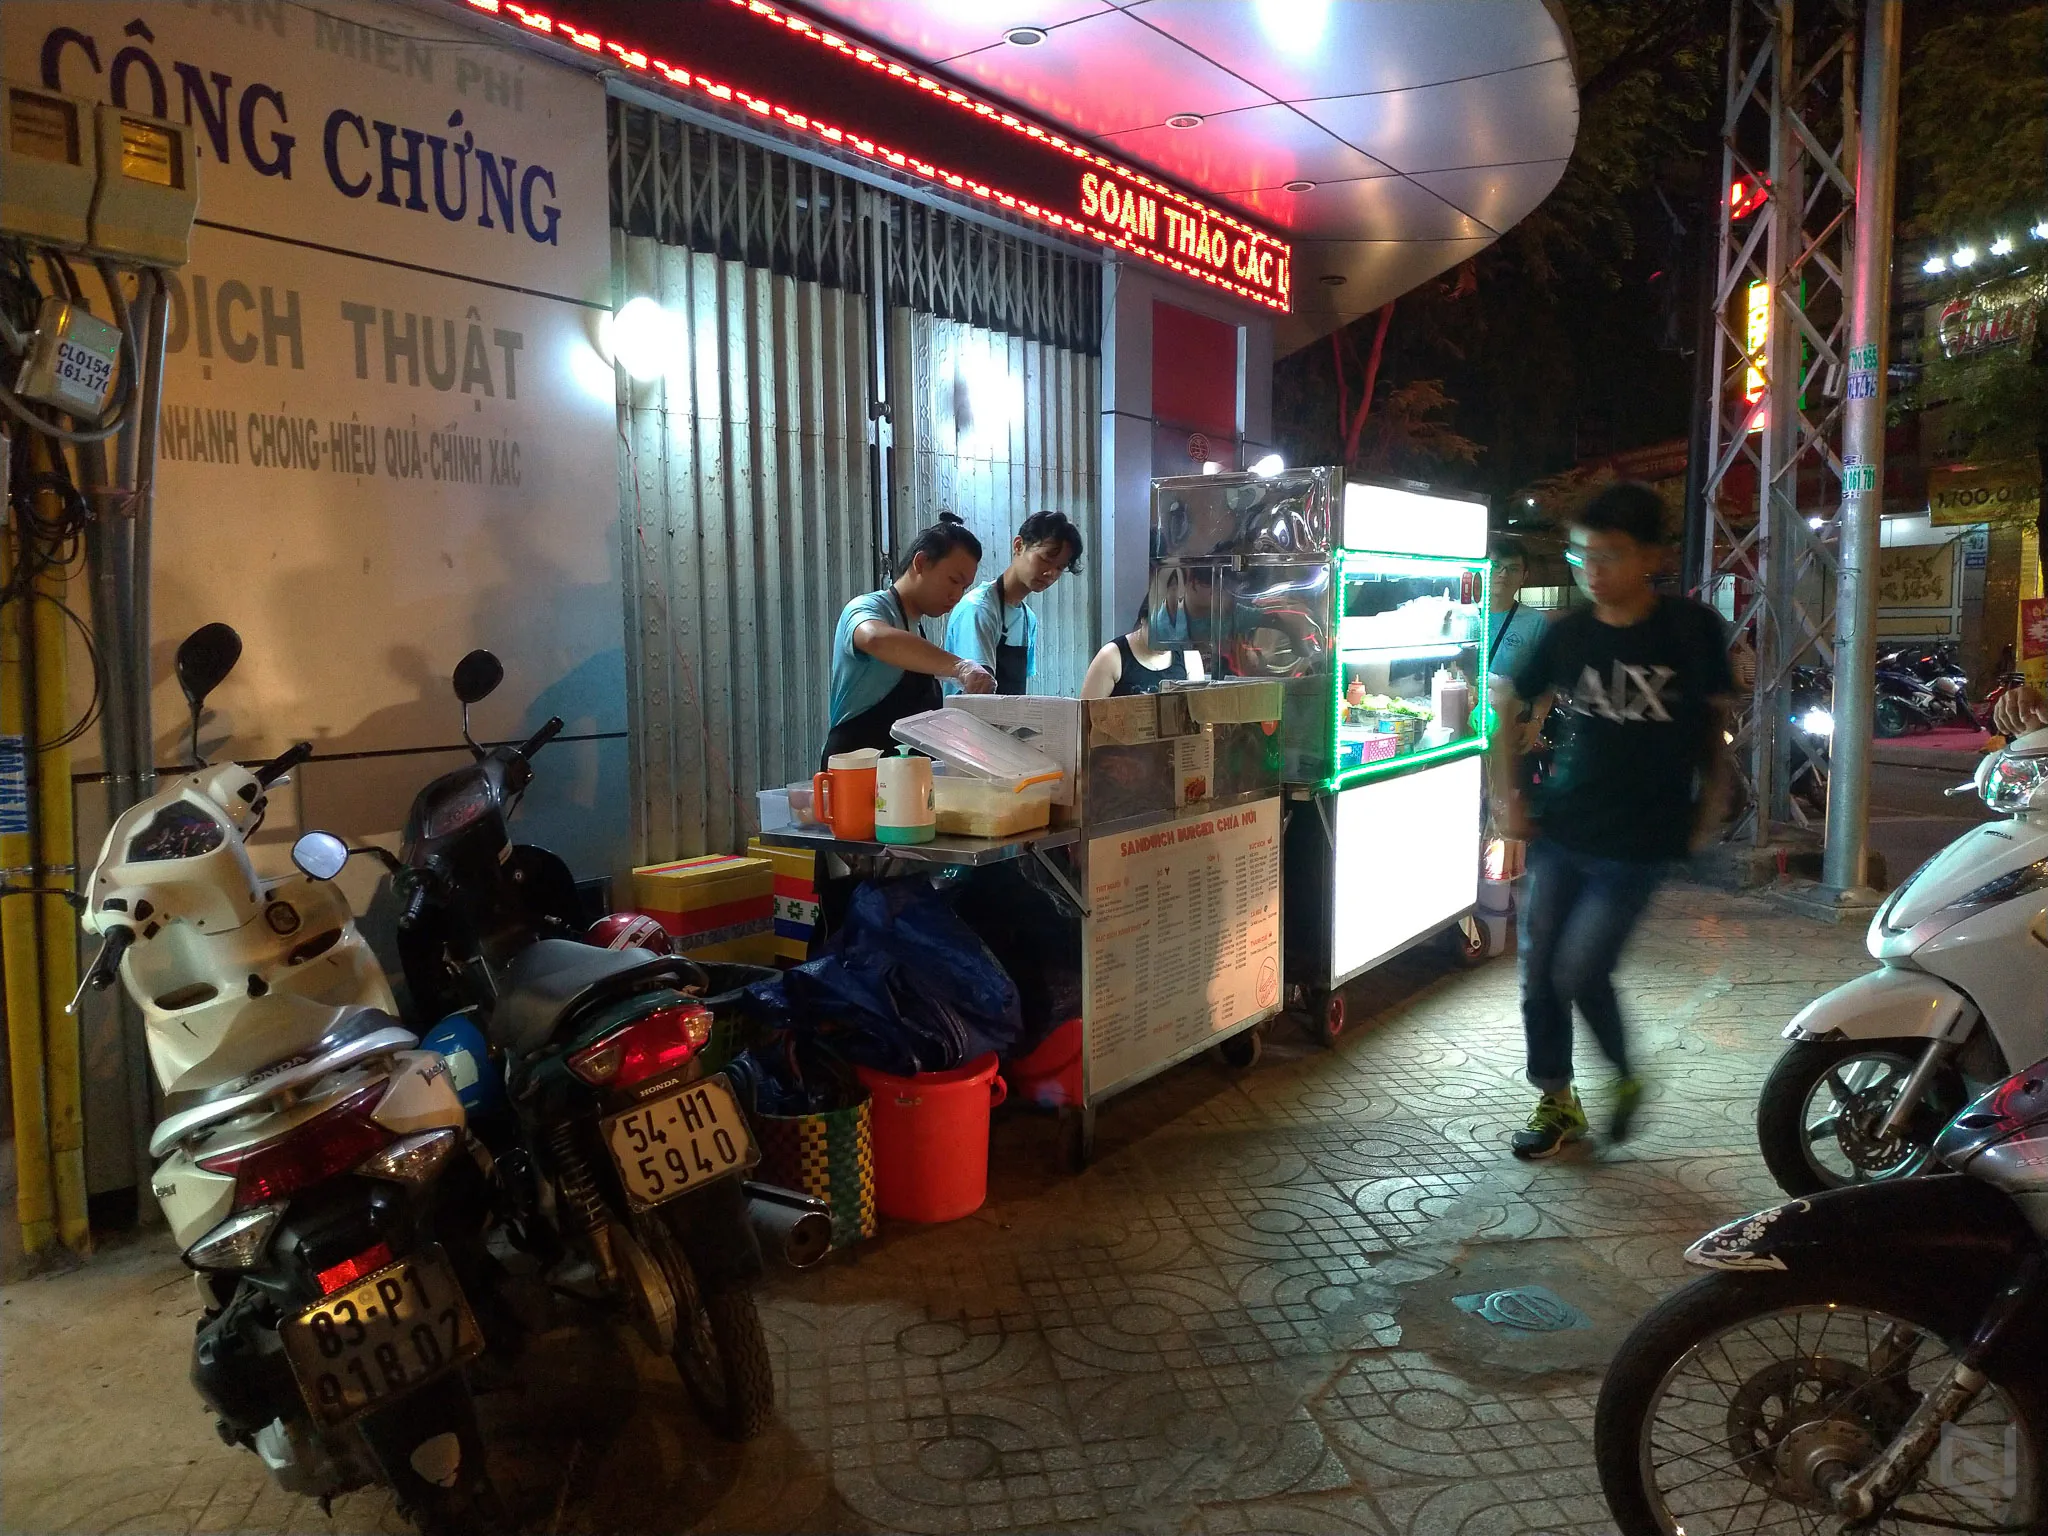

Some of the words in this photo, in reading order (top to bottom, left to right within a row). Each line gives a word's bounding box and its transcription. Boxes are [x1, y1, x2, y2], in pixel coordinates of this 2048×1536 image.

[40, 18, 297, 181] CÔNG
[322, 108, 562, 247] CHỨNG
[1080, 172, 1157, 242] SOẠN
[1163, 209, 1228, 269] THẢO
[1232, 233, 1273, 288] CÁC
[164, 273, 305, 381] DỊCH
[340, 300, 524, 412] THUẬT
[161, 404, 240, 465] NHANH
[1120, 829, 1175, 858] SANDWICH
[1177, 820, 1215, 843] BURGER
[621, 1088, 718, 1154] 54-H1
[639, 1077, 680, 1098] HONDA
[638, 1128, 738, 1195] 5940
[310, 1264, 432, 1360] 83-P1
